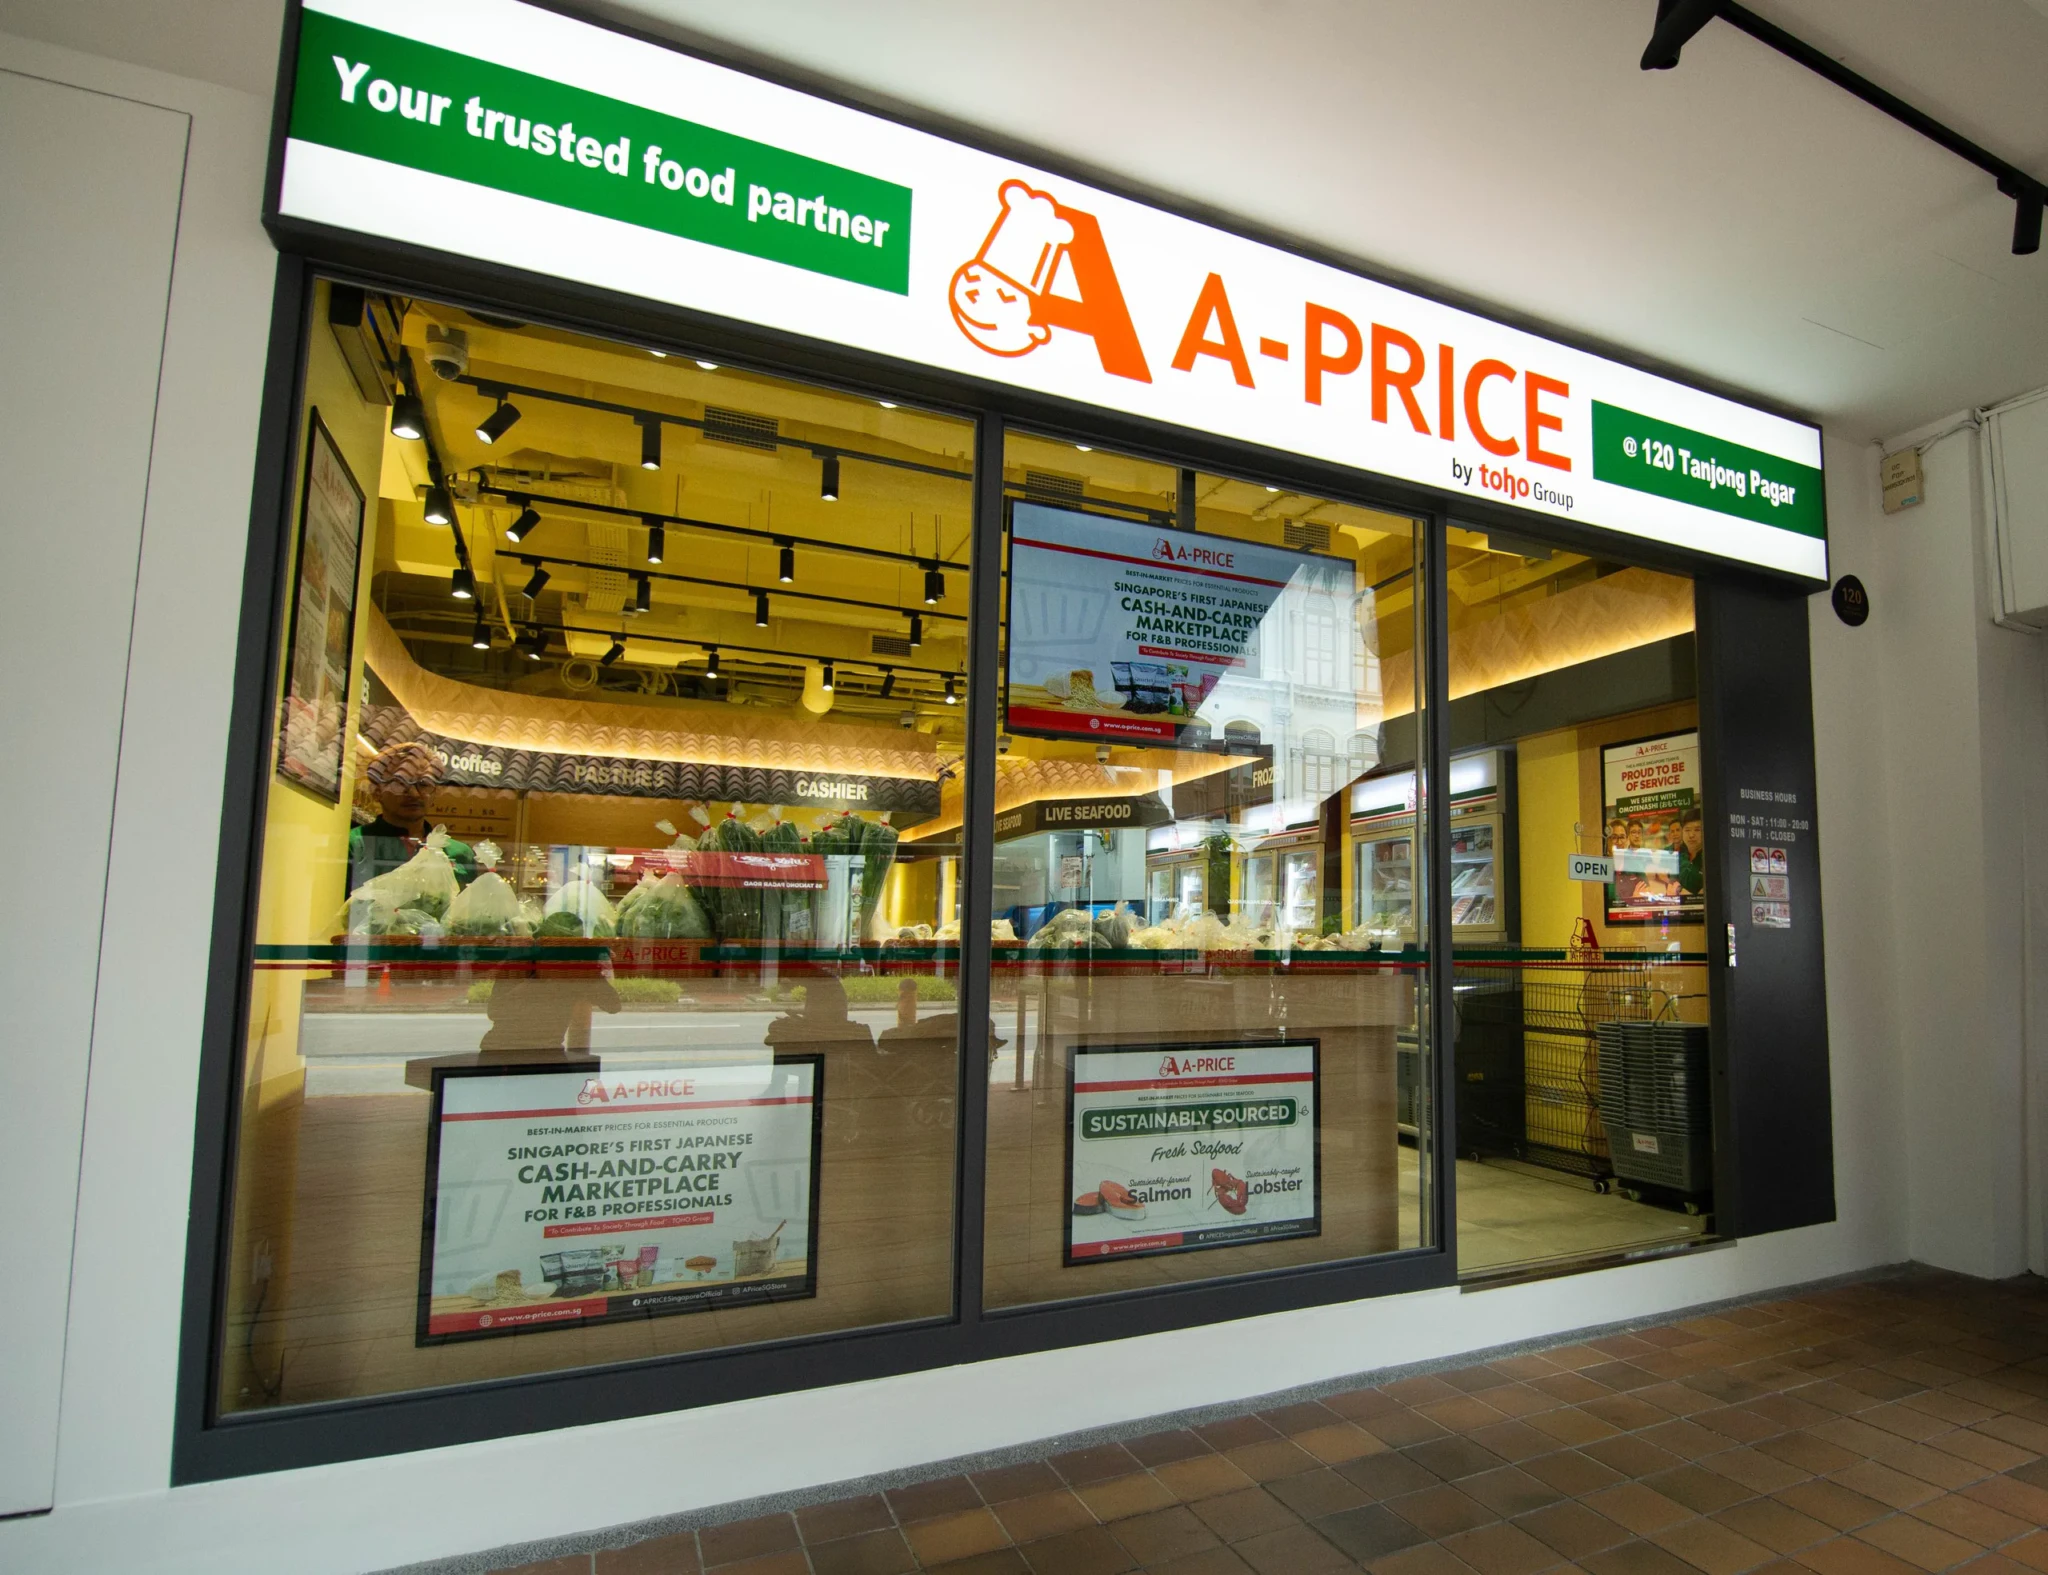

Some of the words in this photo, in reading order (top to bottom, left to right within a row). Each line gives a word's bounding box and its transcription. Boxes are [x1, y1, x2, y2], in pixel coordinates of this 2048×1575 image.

[332, 54, 451, 127] Your
[465, 96, 630, 177] trusted
[643, 146, 735, 206] food
[748, 183, 890, 248] partner
[1171, 272, 1572, 473] A-PRICE
[1623, 436, 1637, 458] @
[1642, 438, 1674, 471] 120
[1678, 448, 1747, 498] Tanjong
[1750, 468, 1796, 508] Pagar
[1452, 459, 1473, 487] by
[1479, 462, 1530, 500] toho
[1534, 482, 1574, 511] Group
[1177, 545, 1235, 568] A-PRICE
[1125, 569, 1173, 583] BEST-IN-MARKET
[1174, 577, 1192, 586] PRICES
[1193, 580, 1203, 588] FOR
[1205, 582, 1232, 593] ESSENTIAL
[1232, 586, 1258, 597] PRODUCTS
[1190, 593, 1217, 606] FIRST
[1219, 598, 1269, 614] JAPANESE
[1842, 587, 1862, 604] 120
[1121, 597, 1263, 629] CASH-AND-CARRY
[1136, 615, 1249, 643] MARKETPLACE
[1126, 630, 1148, 643] FOR
[1151, 634, 1172, 646] F&B
[1175, 636, 1258, 657] PROFESSIONALS
[1103, 721, 1162, 734] www.a-price.com.sg
[1644, 742, 1668, 754] A-PRICE
[451, 754, 503, 776] coffee
[1621, 767, 1655, 781] PROUD
[1656, 764, 1670, 776] TO
[1671, 762, 1685, 773] BE
[574, 764, 665, 788] PASTRIES
[1626, 781, 1639, 792] OF
[1640, 774, 1681, 790] SERVICE
[796, 780, 869, 801] CASHIER
[1630, 797, 1640, 805] WE
[1641, 794, 1659, 804] SERVE
[1660, 792, 1677, 801] WITH
[1740, 788, 1774, 802] BUSINESS
[1774, 792, 1797, 804] HOURS
[1045, 806, 1072, 821] LIVE
[1074, 804, 1131, 820] SEAFOOD
[1618, 802, 1659, 814] OMOTENASHI
[1730, 813, 1746, 825] MON
[1751, 815, 1764, 827] SAT
[1792, 819, 1809, 831] 20:00
[1730, 827, 1745, 839] SUN
[1752, 829, 1762, 839] PH
[1770, 830, 1796, 842] CLOSED
[1574, 861, 1609, 877] OPEN
[623, 946, 688, 960] A-PRICE
[1182, 1056, 1236, 1073] A-PRICE
[612, 1079, 696, 1100] A-PRICE
[527, 1124, 603, 1136] BEST-IN-MARKET
[604, 1123, 633, 1132] PRICES
[634, 1121, 651, 1130] FOR
[653, 1119, 695, 1129] ESSENTIAL
[696, 1117, 738, 1126] PRODUCTS
[1090, 1109, 1209, 1133] SUSTAINABLY
[1212, 1104, 1290, 1125] SOURCED
[507, 1141, 625, 1160] SINGAPORE'S
[629, 1138, 671, 1152] FIRST
[675, 1133, 753, 1150] JAPANESE
[1150, 1142, 1188, 1163] Fresh
[1190, 1140, 1244, 1161] Seafood
[518, 1151, 743, 1184] CASH-AND-CARRY
[541, 1173, 720, 1204] MARKETPLACE
[1127, 1185, 1192, 1205] Salmon
[1245, 1178, 1303, 1196] Lobster
[524, 1208, 560, 1222] FOR
[564, 1205, 597, 1220] F&B
[602, 1194, 733, 1216] PROFESSIONALS
[643, 1289, 723, 1306] APRICESingaporeOfficial
[742, 1282, 787, 1294] APriceSGStore
[499, 1306, 582, 1324] www.a-price.com.sg
